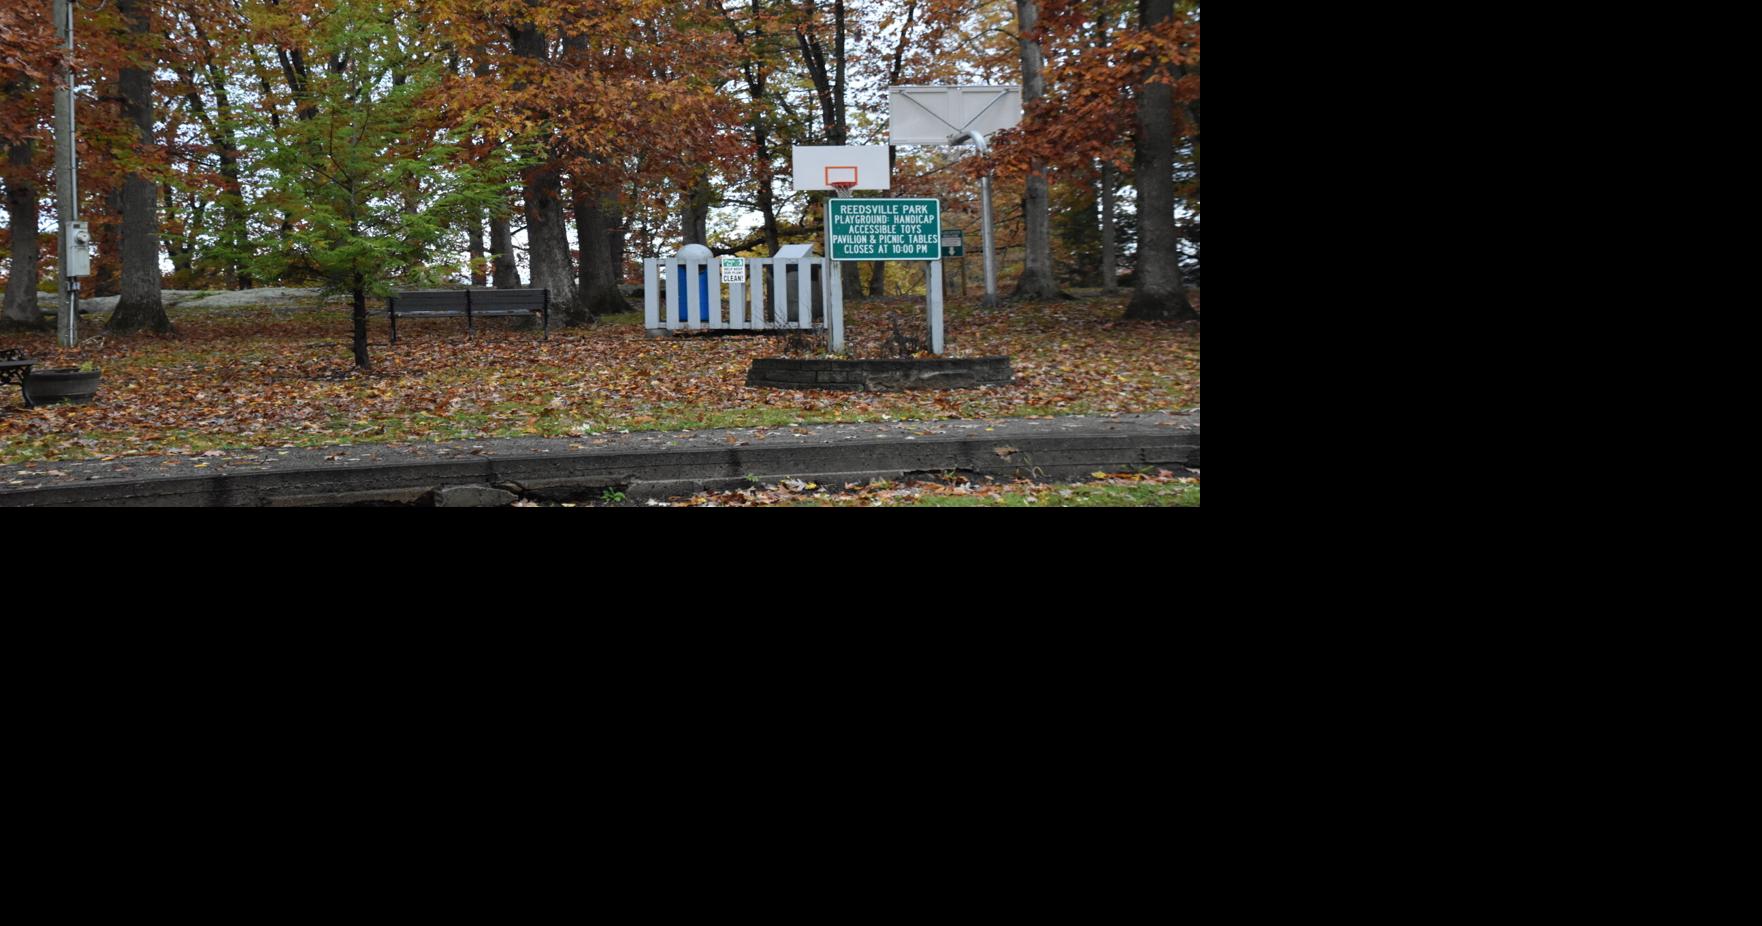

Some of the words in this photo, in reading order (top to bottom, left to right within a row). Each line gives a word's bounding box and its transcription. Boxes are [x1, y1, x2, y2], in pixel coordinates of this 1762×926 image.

[840, 205, 899, 214] REEDSVILLE
[902, 205, 928, 214] PARK
[893, 215, 935, 224] HANDICAP
[848, 225, 897, 234] ACCESSIBLE
[901, 225, 922, 234] TOYS
[832, 235, 867, 244] PAVILION
[870, 235, 877, 244] &
[879, 235, 905, 244] PICNIC
[908, 235, 938, 244] TABLES
[844, 245, 874, 254] CLOSES
[878, 245, 888, 254] AT
[893, 245, 914, 254] 10:00
[916, 245, 928, 254] PM
